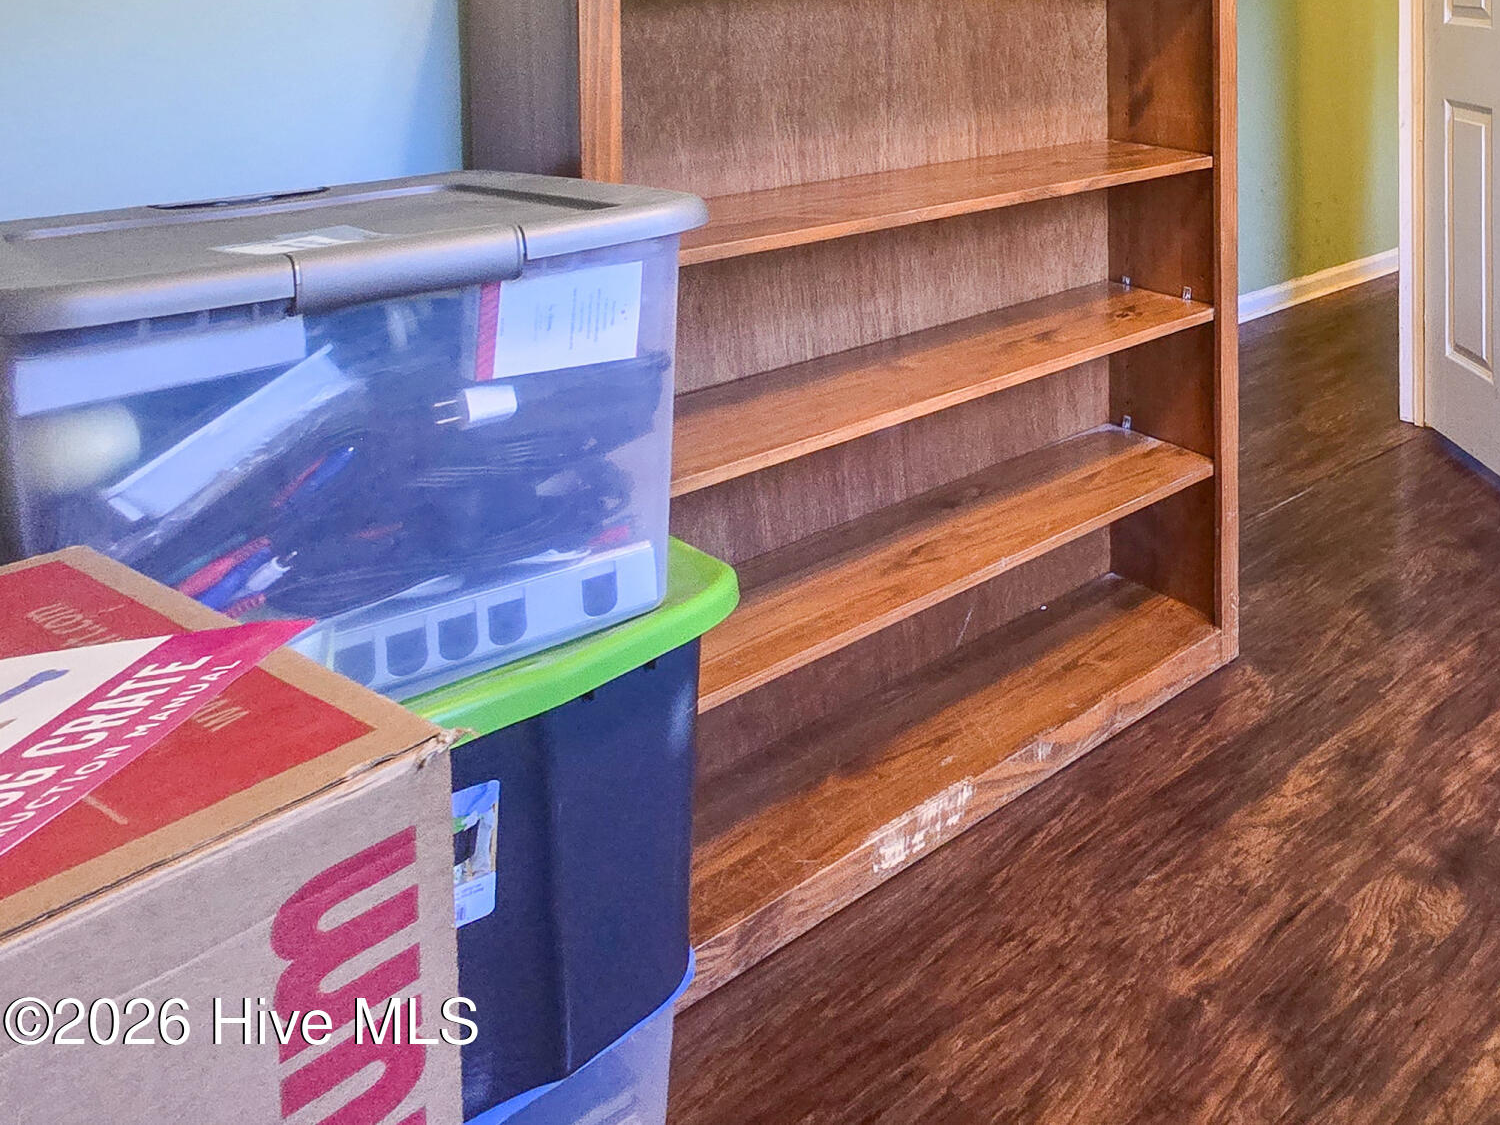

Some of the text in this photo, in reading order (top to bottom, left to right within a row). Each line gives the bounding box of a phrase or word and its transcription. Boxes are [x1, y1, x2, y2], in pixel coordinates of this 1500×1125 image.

[0, 744, 131, 838] UCTION
[123, 660, 242, 739] MANUAL
[21, 655, 214, 758] CRATE
